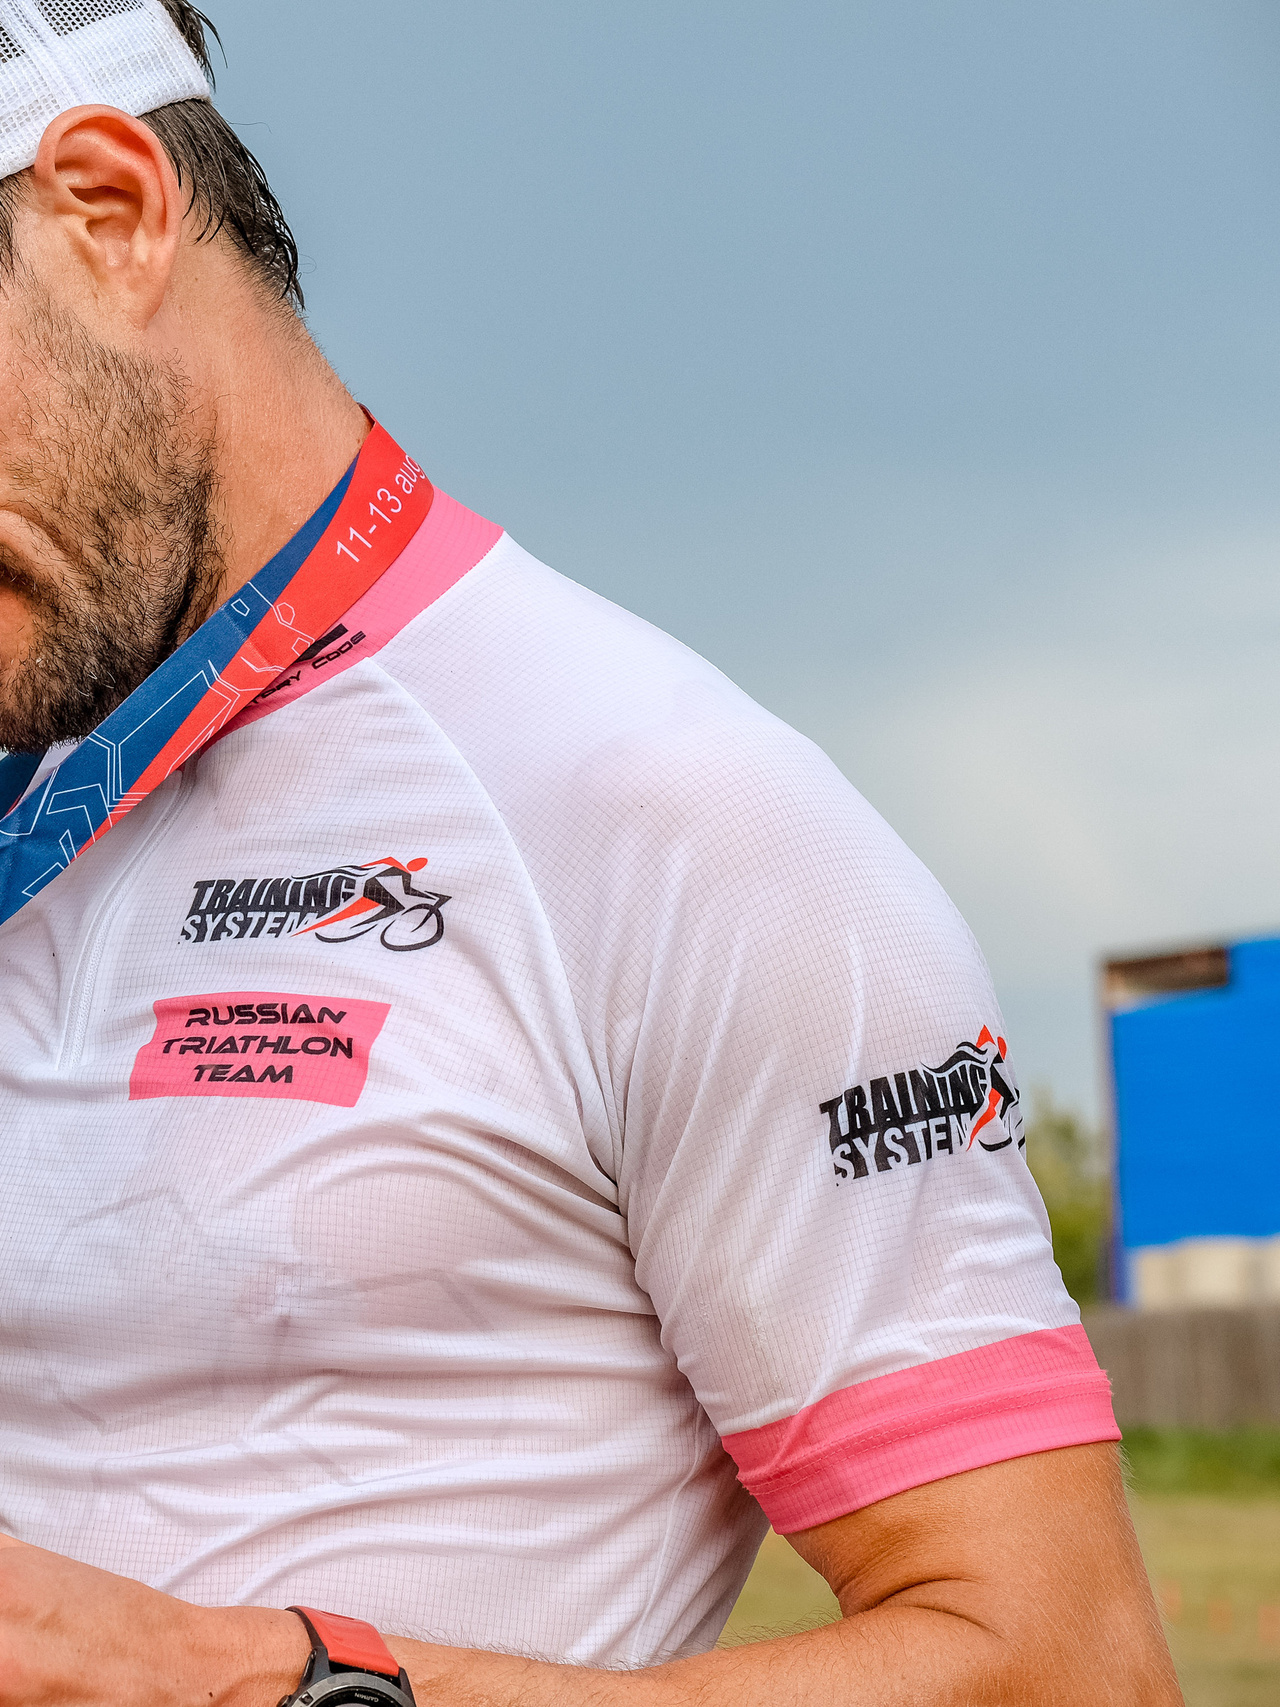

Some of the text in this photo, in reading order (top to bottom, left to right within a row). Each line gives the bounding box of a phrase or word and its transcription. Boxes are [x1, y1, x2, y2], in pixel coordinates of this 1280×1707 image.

[335, 487, 402, 563] 11-13
[188, 874, 356, 914] TRAINING
[179, 908, 323, 944] SYSTEM
[184, 1002, 348, 1029] RUSSIAN
[161, 1035, 354, 1060] TRIATHLON
[193, 1063, 294, 1084] TEAM
[818, 1062, 987, 1142] TRAINING
[832, 1112, 972, 1182] SYSTEM
[354, 1692, 379, 1702] GARMIN
